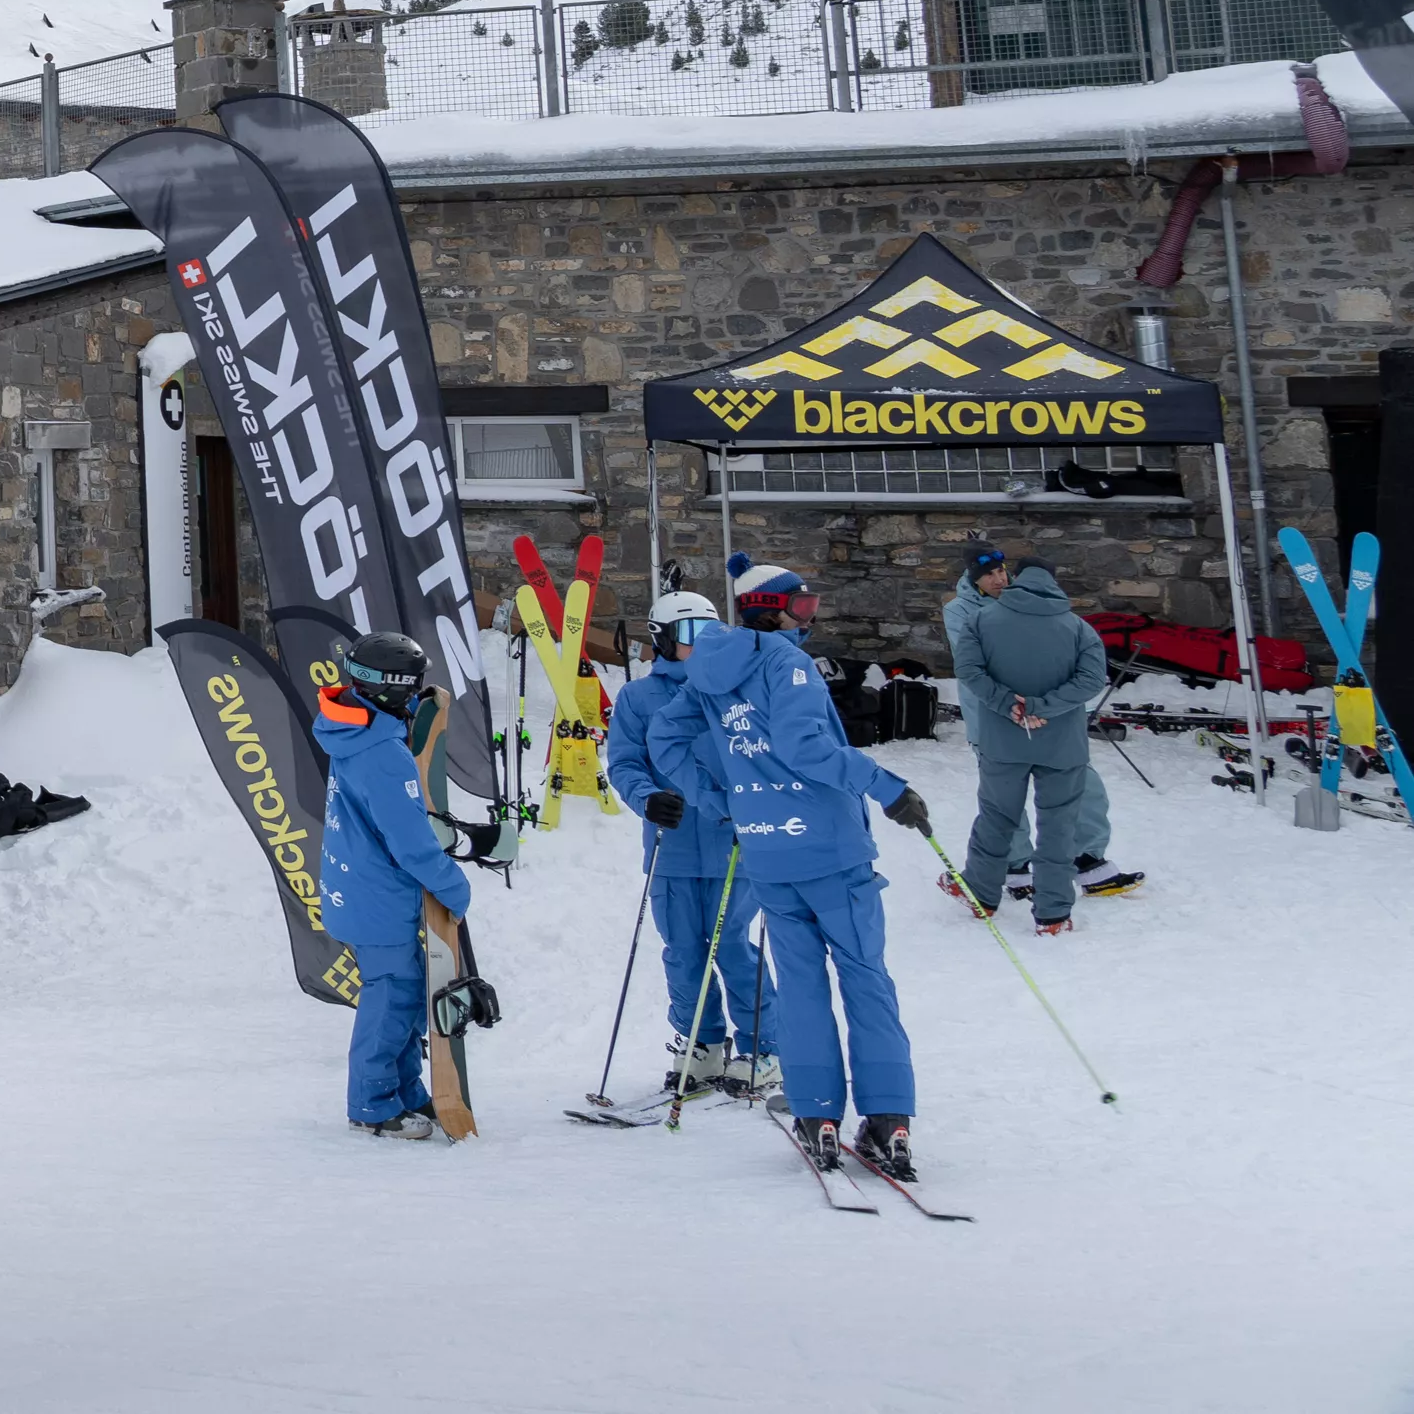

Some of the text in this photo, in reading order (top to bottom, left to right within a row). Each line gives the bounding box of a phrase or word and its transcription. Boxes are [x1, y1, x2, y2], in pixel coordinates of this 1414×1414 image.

[793, 390, 1147, 436] blackcrows
[179, 441, 191, 577] Centro médico
[733, 781, 803, 794] OLVO
